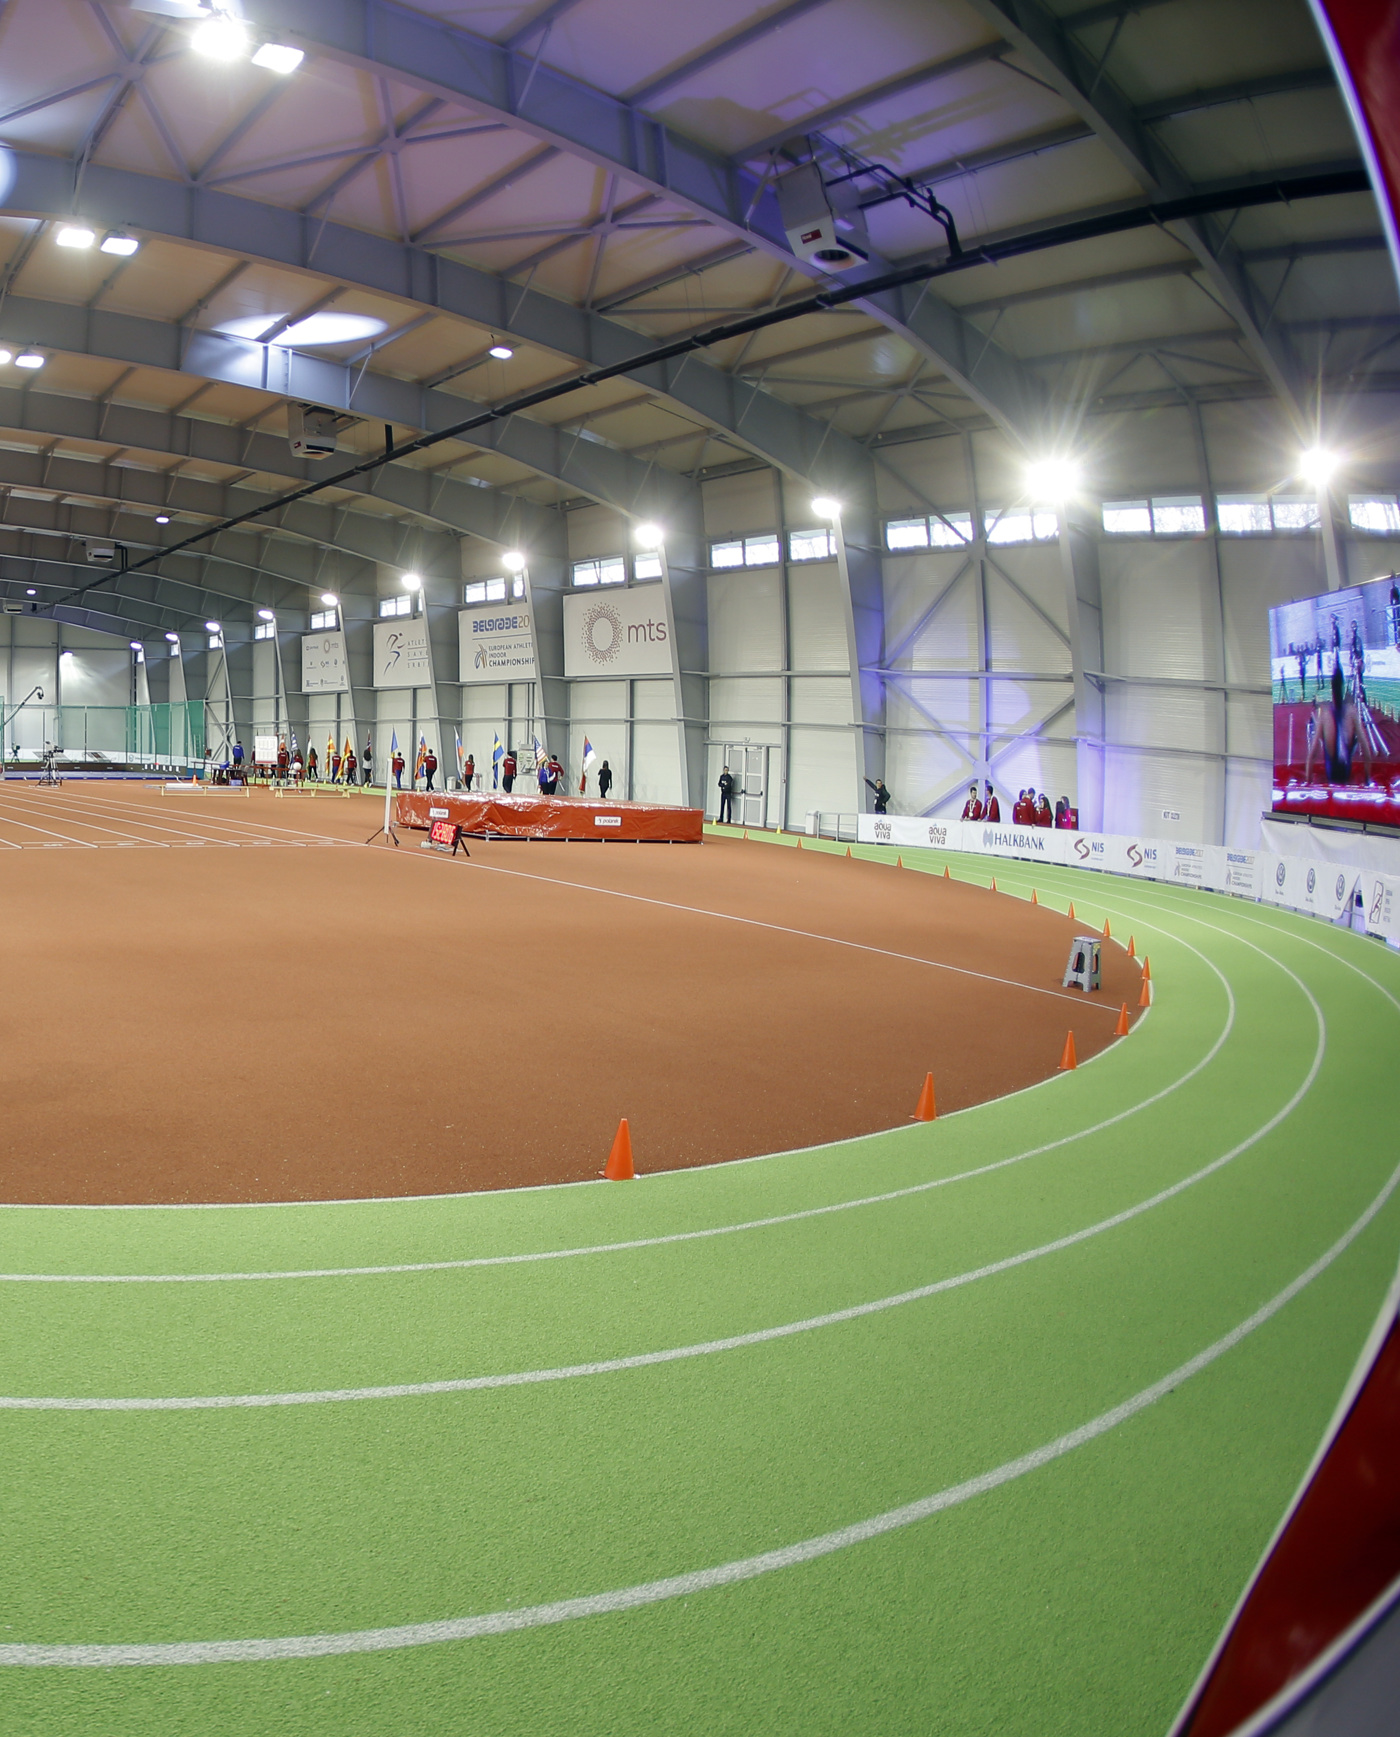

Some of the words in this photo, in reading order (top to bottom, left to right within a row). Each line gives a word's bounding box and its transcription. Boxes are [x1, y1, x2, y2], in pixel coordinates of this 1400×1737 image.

[628, 618, 667, 643] mts
[488, 643, 512, 651] EUROPEAN
[874, 821, 892, 832] aqua
[928, 825, 947, 836] aqua
[875, 831, 891, 840] viva
[929, 835, 946, 845] viva
[994, 832, 1045, 851] HALKBANK
[1091, 841, 1104, 853] NIS
[1144, 848, 1157, 860] NIS
